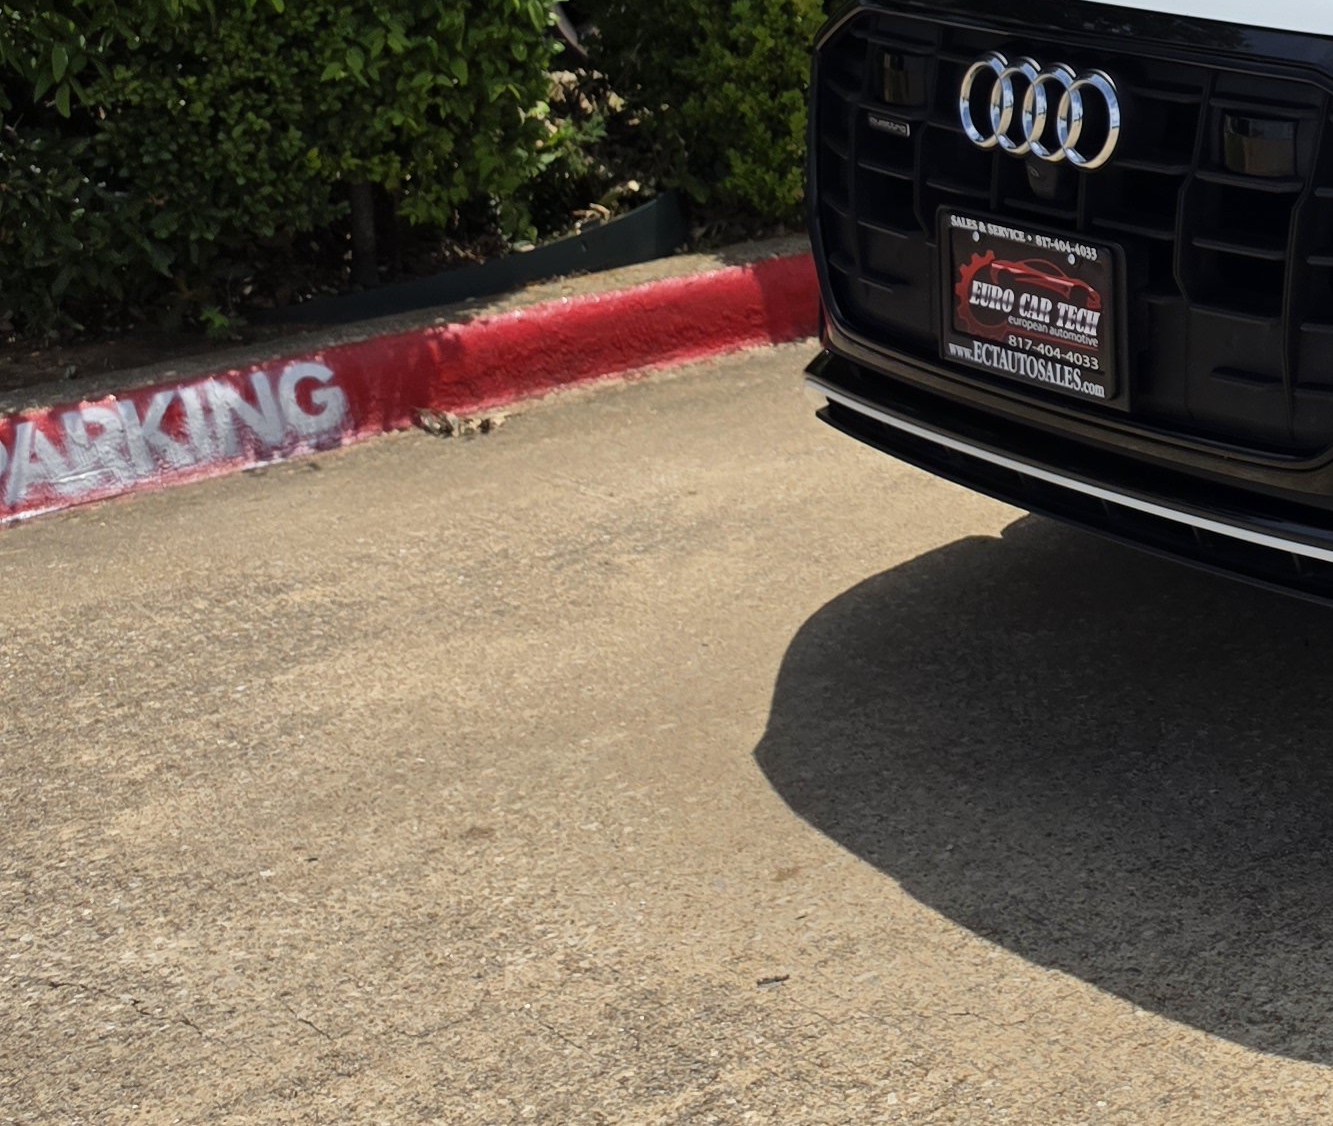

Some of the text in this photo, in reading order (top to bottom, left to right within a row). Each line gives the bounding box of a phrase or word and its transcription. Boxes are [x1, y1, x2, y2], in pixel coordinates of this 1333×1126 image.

[951, 214, 1098, 262] SALES & SERVICE 817-404-4033
[969, 280, 1101, 337] EURO CAR TECH
[1007, 315, 1099, 348] european automotive
[948, 340, 1105, 398] www.ECTAUTOSALES.com
[1008, 334, 1100, 371] 817-404-4033
[0, 362, 349, 505] ARKING
